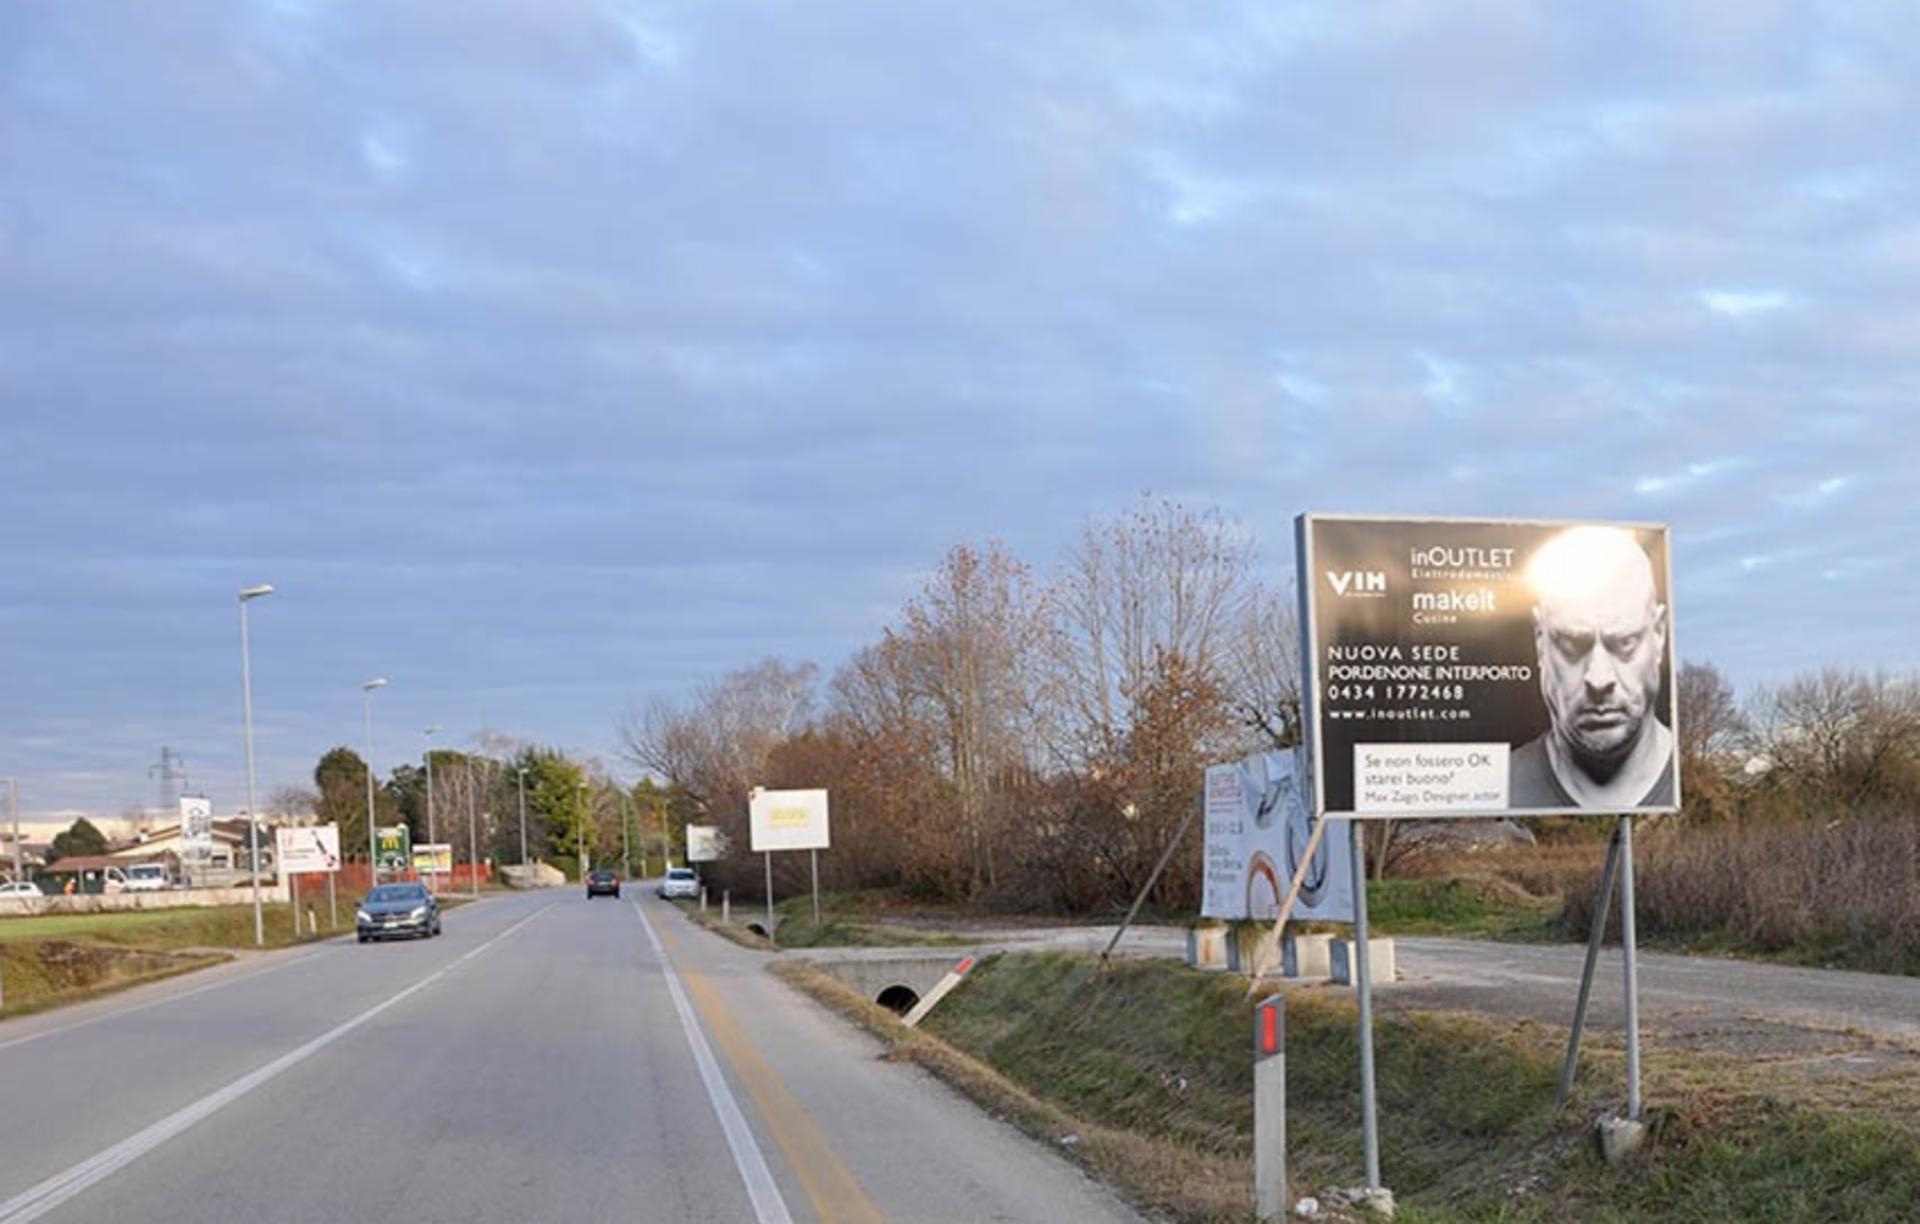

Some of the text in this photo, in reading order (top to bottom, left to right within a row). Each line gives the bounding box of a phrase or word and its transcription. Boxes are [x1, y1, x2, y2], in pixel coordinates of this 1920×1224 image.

[1411, 547, 1514, 567] inOUTLET
[1413, 588, 1495, 611] makeit
[1328, 646, 1460, 661] NUOVA SEDE
[1328, 665, 1532, 681] PORDENONE INTERPORTO
[1328, 685, 1464, 700] 0434 1772468
[1329, 707, 1471, 720] www.inoutlet.com
[1365, 753, 1491, 767] Se non fossero OK
